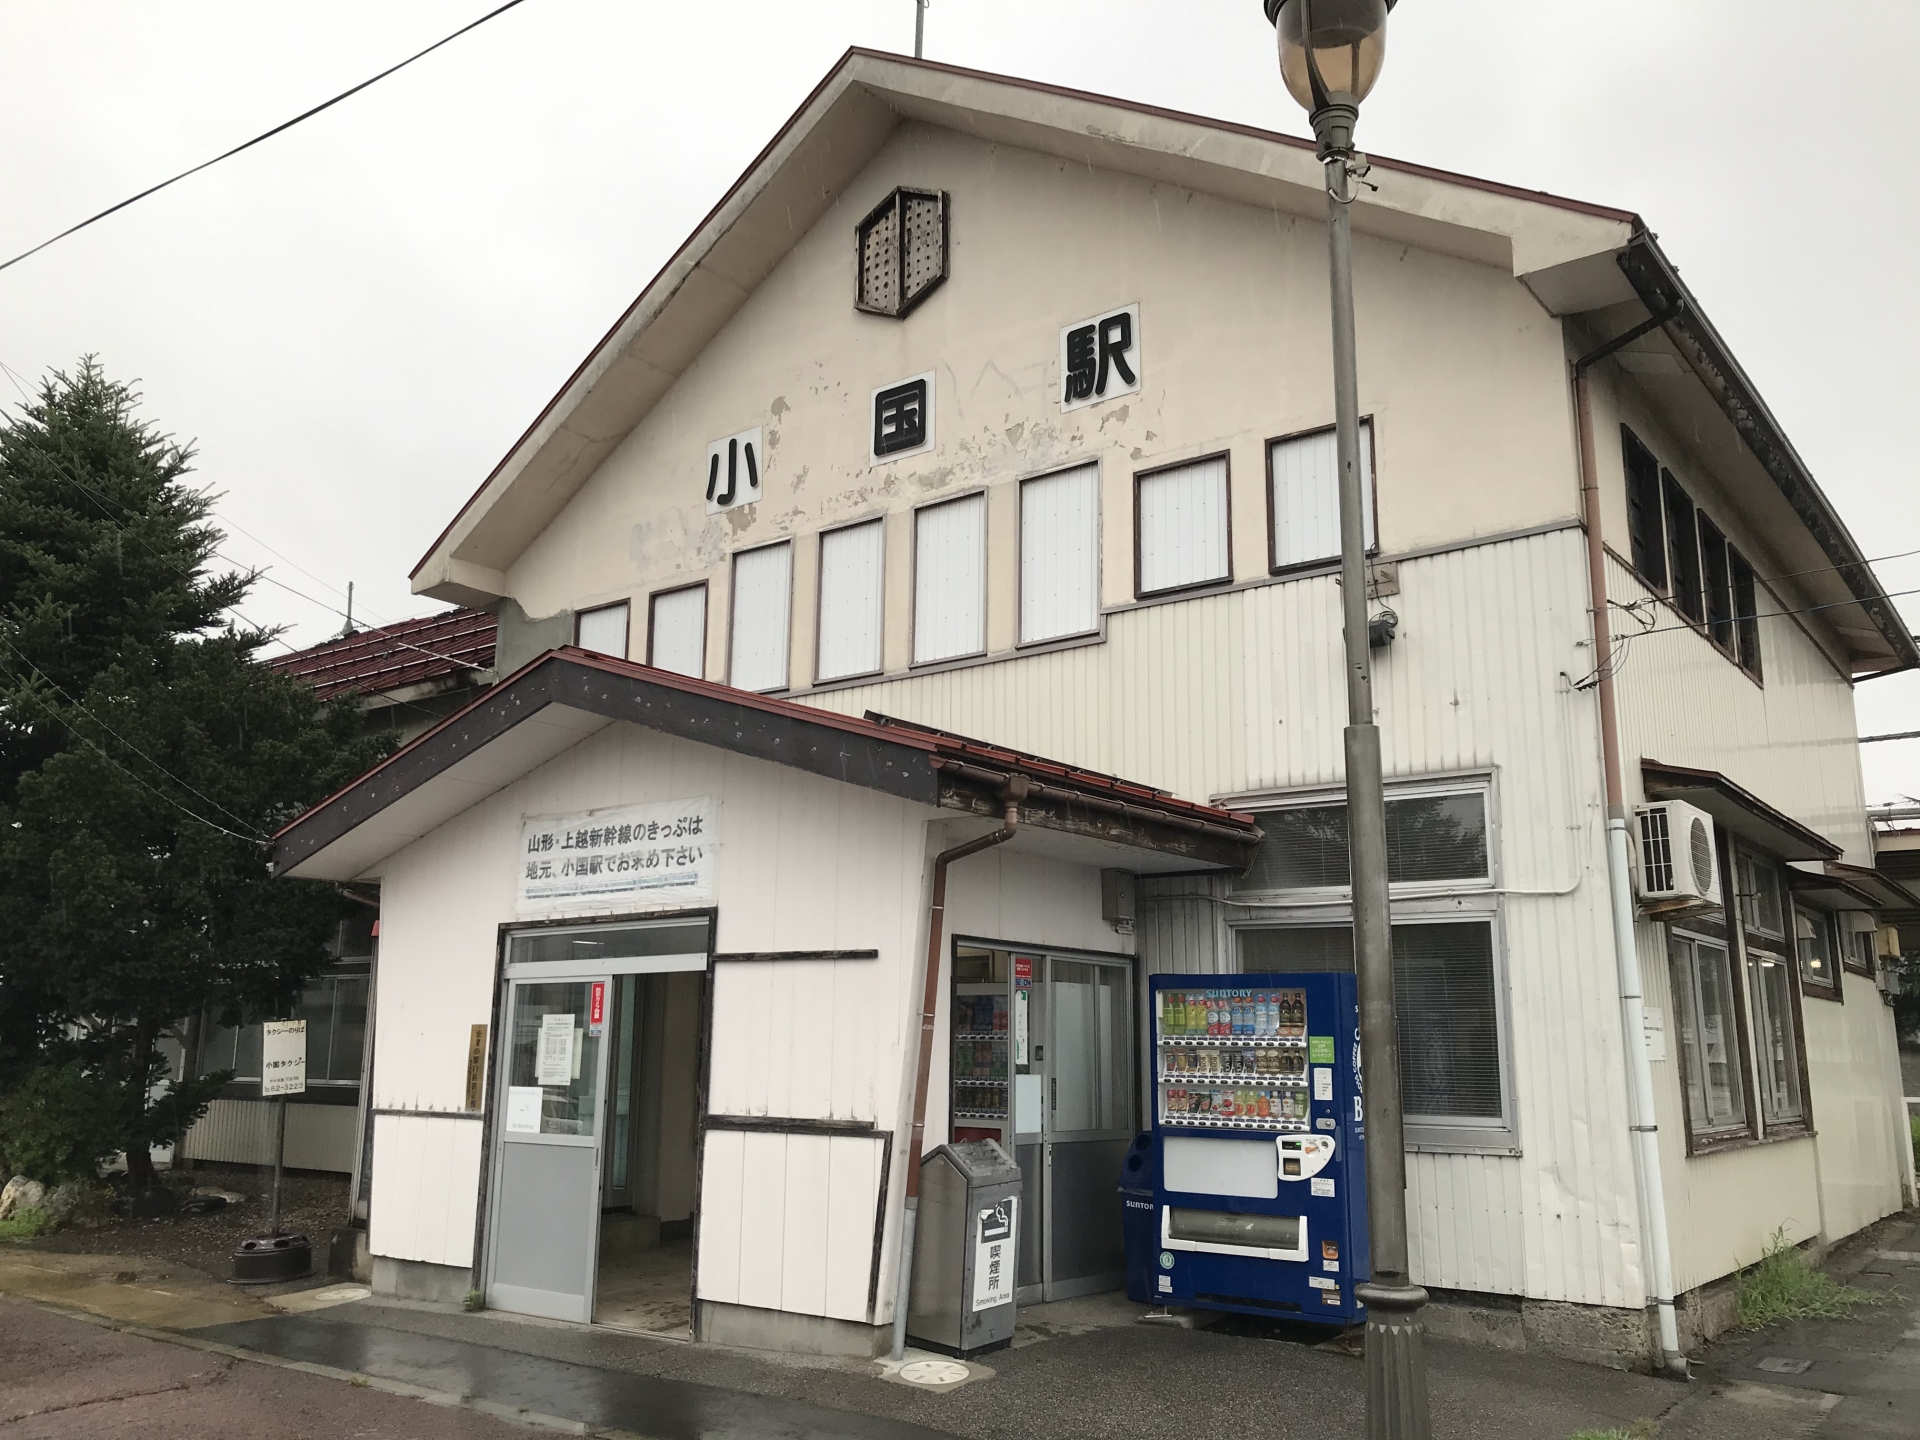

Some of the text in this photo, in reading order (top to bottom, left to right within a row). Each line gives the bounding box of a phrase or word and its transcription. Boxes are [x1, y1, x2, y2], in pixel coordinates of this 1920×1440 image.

[706, 312, 1136, 505] 小国駅
[528, 815, 703, 853] 山形・上越新幹線のきっぷは
[1206, 989, 1252, 998] SUNTORY
[266, 1026, 305, 1036] タクシーのりば
[988, 1244, 1002, 1291] 喫煙所
